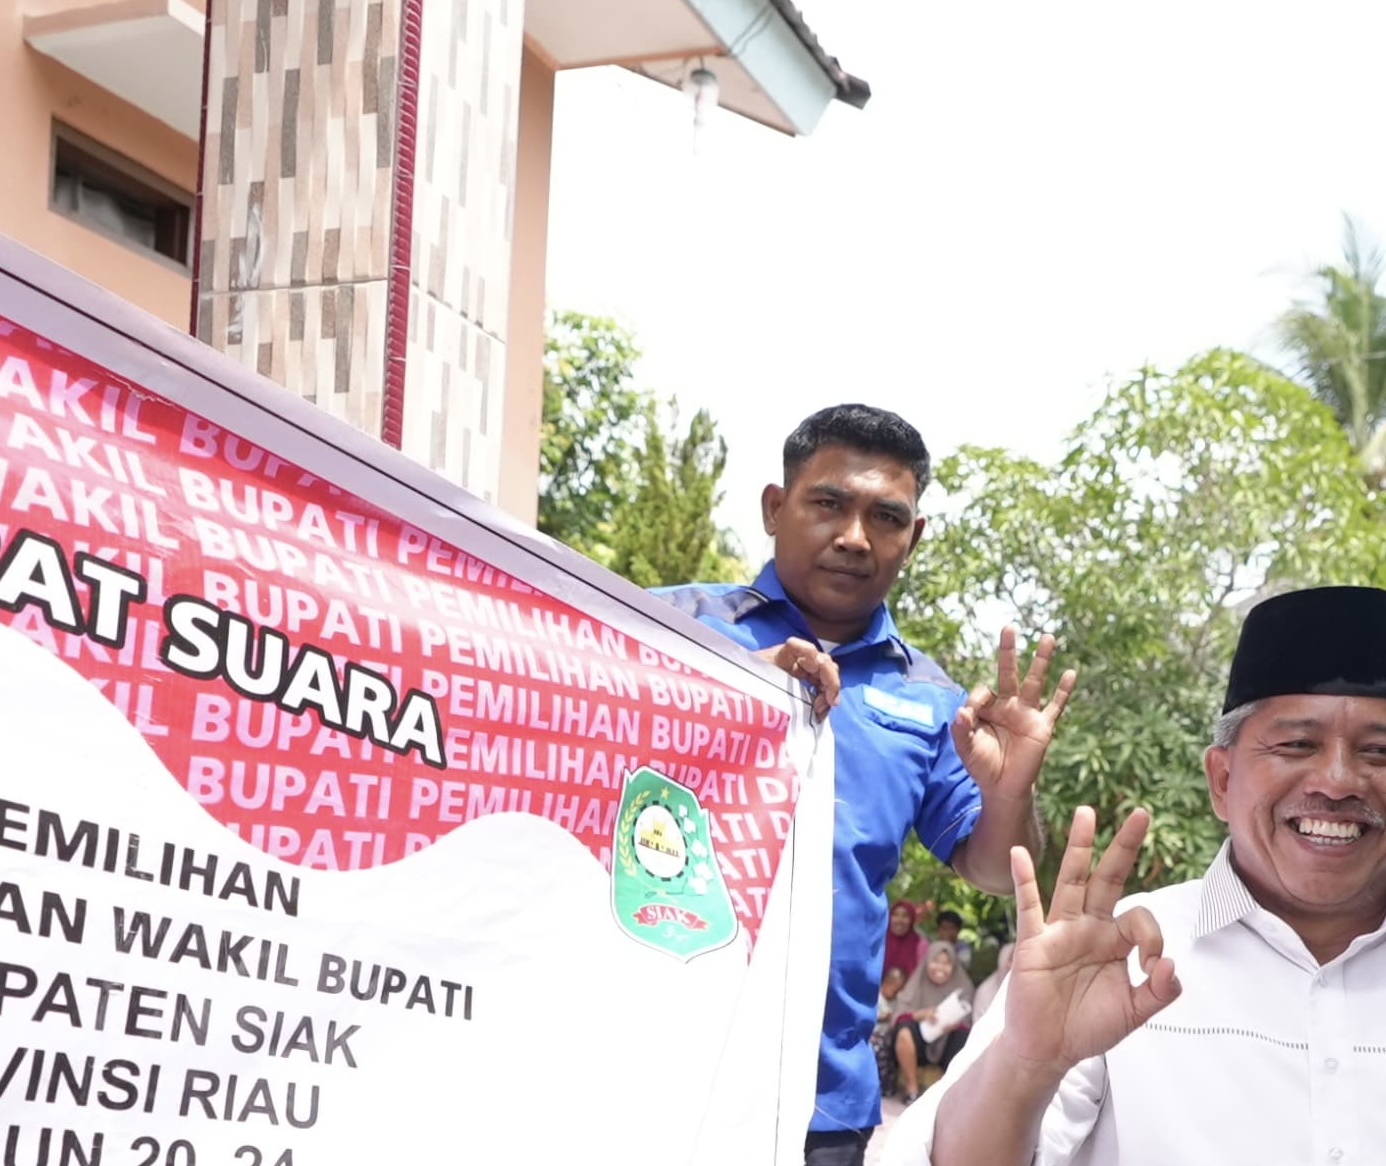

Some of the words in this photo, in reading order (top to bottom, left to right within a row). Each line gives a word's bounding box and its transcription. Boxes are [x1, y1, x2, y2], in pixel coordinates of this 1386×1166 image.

[178, 467, 379, 558] BUPATI
[192, 516, 396, 602] BUPATI
[400, 572, 627, 662] PEMILIHAN
[162, 595, 446, 769] SUARA
[203, 569, 404, 653] BUPATI
[416, 615, 640, 700] PEMILIHAN
[647, 673, 755, 725] BUPATI
[414, 727, 638, 790] EMILIHAN
[421, 668, 641, 746] PEMILIHAN
[651, 714, 752, 766] BUPATI
[186, 755, 393, 820] BUPATI
[112, 905, 300, 987] WAKIL
[316, 952, 474, 1022] BUPATI
[230, 1004, 362, 1069] SIAK
[178, 1068, 321, 1130] RIAU
